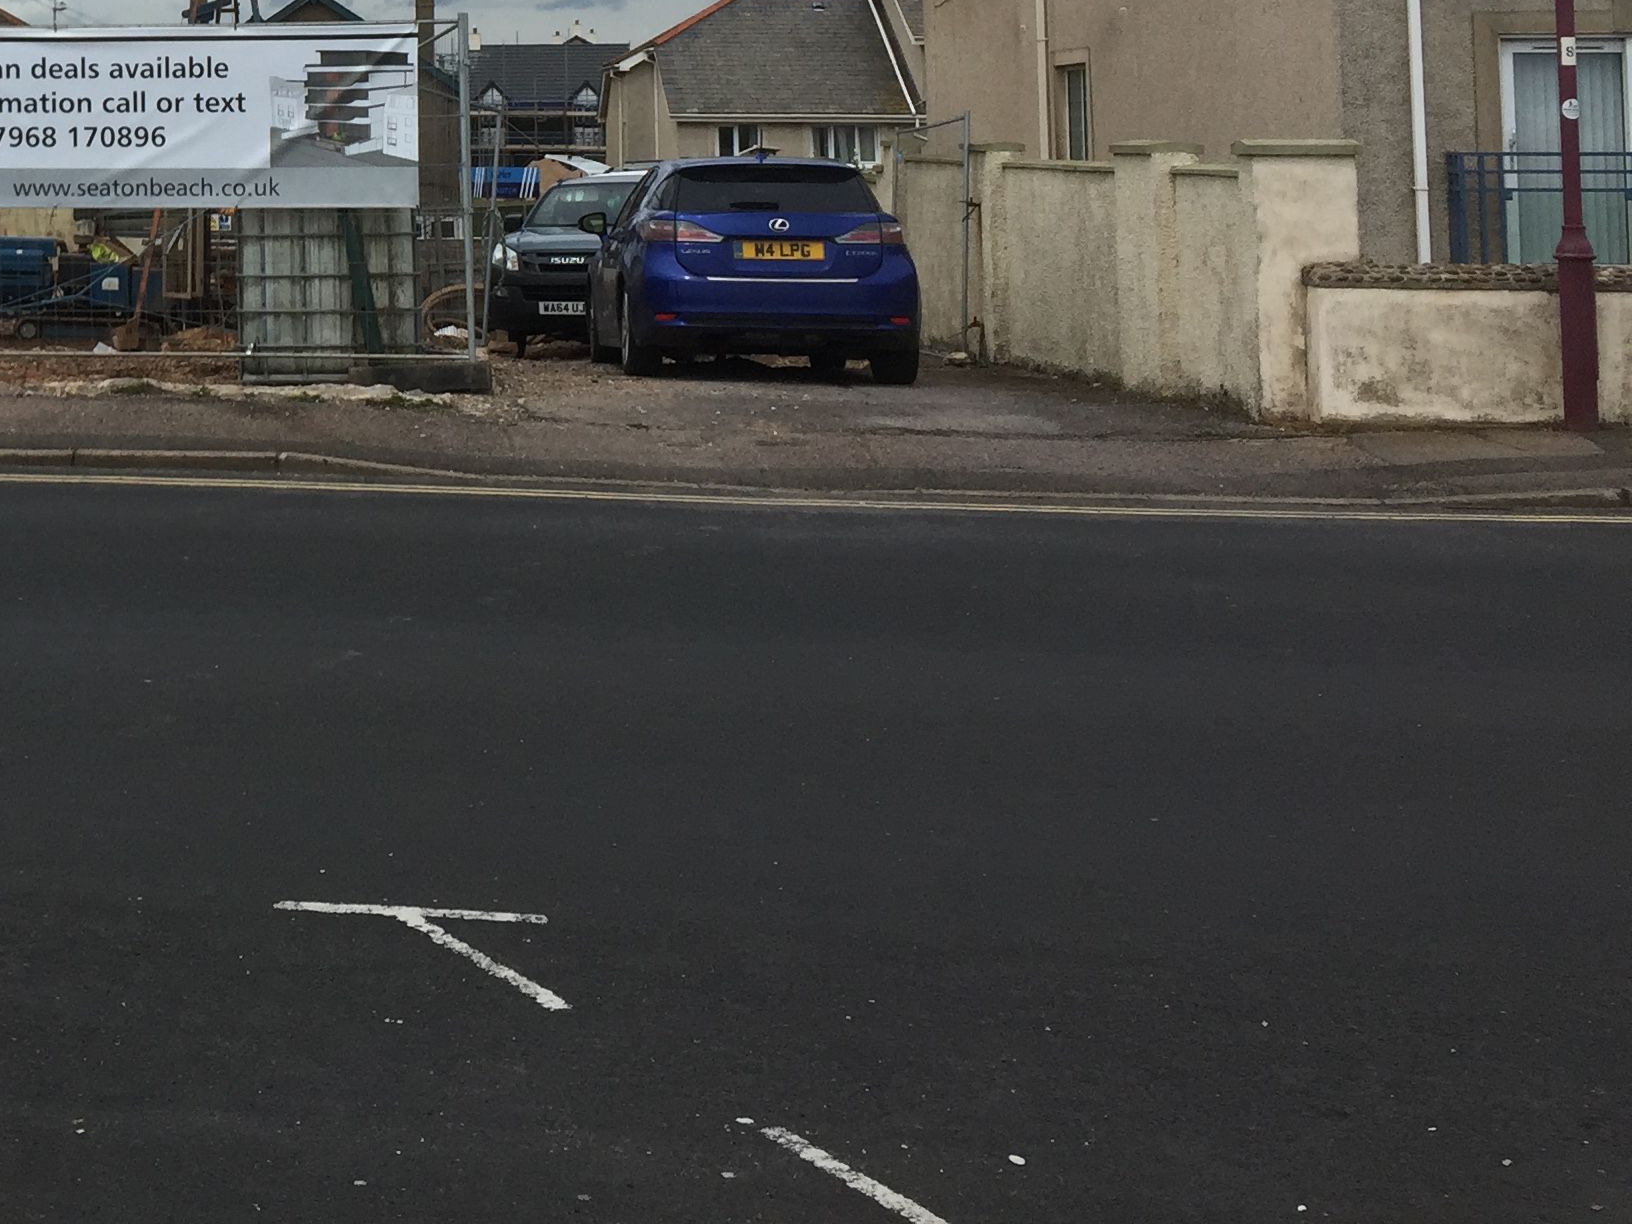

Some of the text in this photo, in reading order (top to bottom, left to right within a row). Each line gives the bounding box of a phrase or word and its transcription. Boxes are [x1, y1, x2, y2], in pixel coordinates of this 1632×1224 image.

[31, 57, 99, 79] deals
[110, 56, 228, 79] available
[103, 91, 145, 113] call
[157, 97, 184, 113] or
[194, 93, 246, 112] text
[69, 126, 165, 147] 170896
[13, 176, 279, 196] www.seatonbeach.co.uk
[550, 256, 585, 264] ISUZU
[780, 243, 811, 257] LPG
